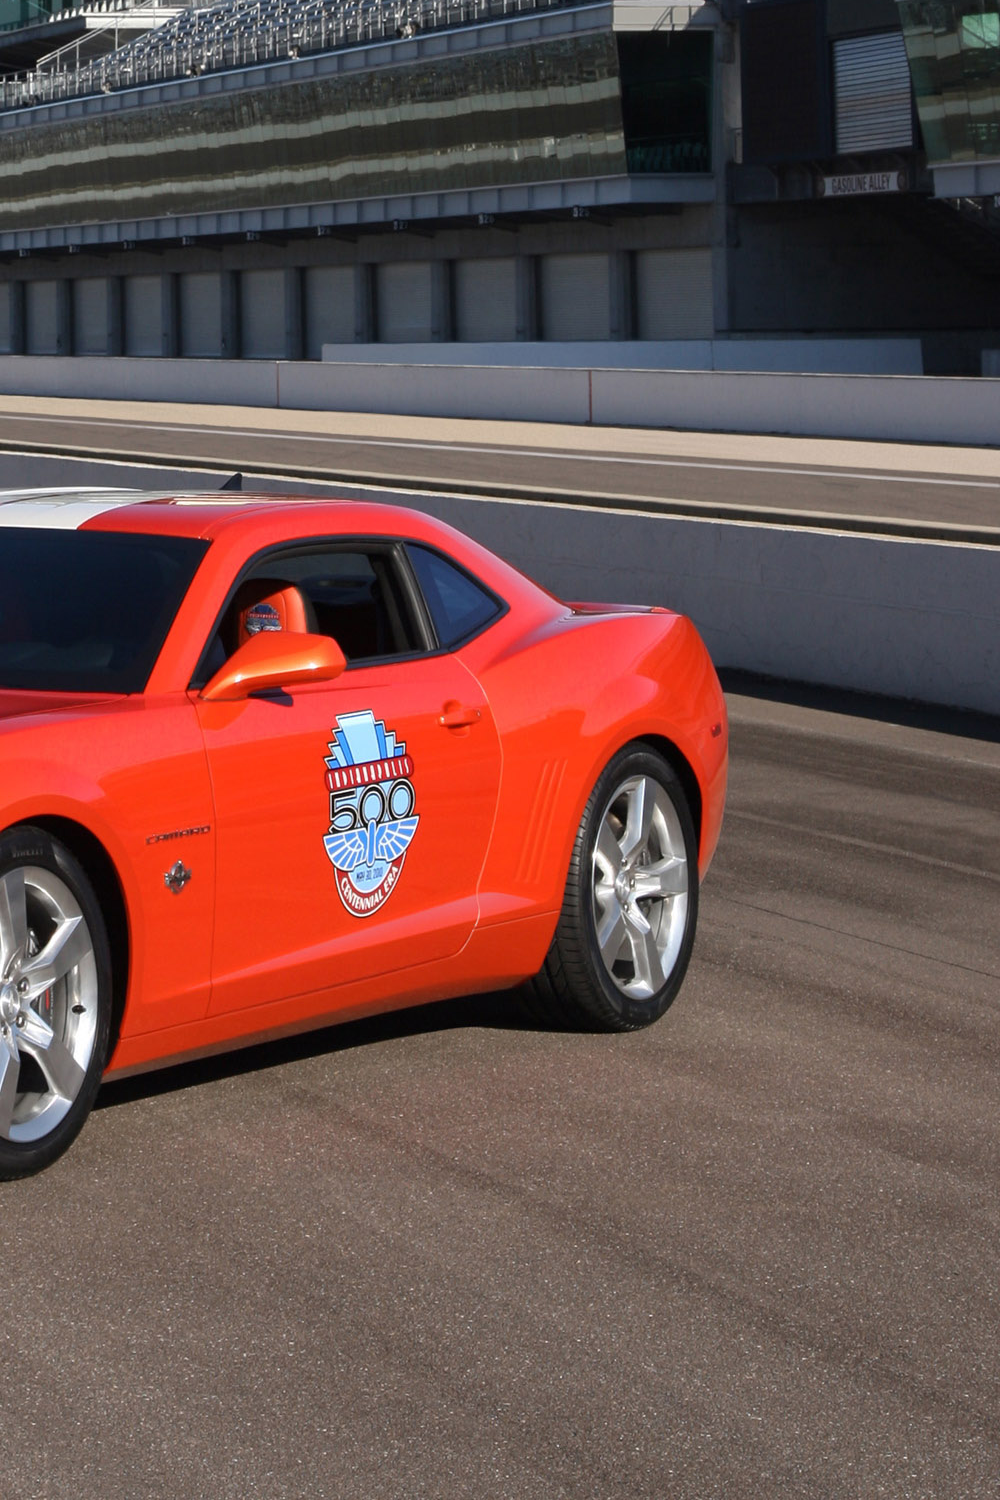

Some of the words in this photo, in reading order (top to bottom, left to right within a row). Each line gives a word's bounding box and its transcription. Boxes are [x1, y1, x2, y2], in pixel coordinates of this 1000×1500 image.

[832, 175, 866, 193] GASOLINE
[868, 173, 890, 191] ALLEY
[329, 778, 415, 833] 500
[146, 825, 211, 845] CAMARO
[341, 877, 384, 910] CENTENNIAL
[383, 866, 398, 892] ERA
